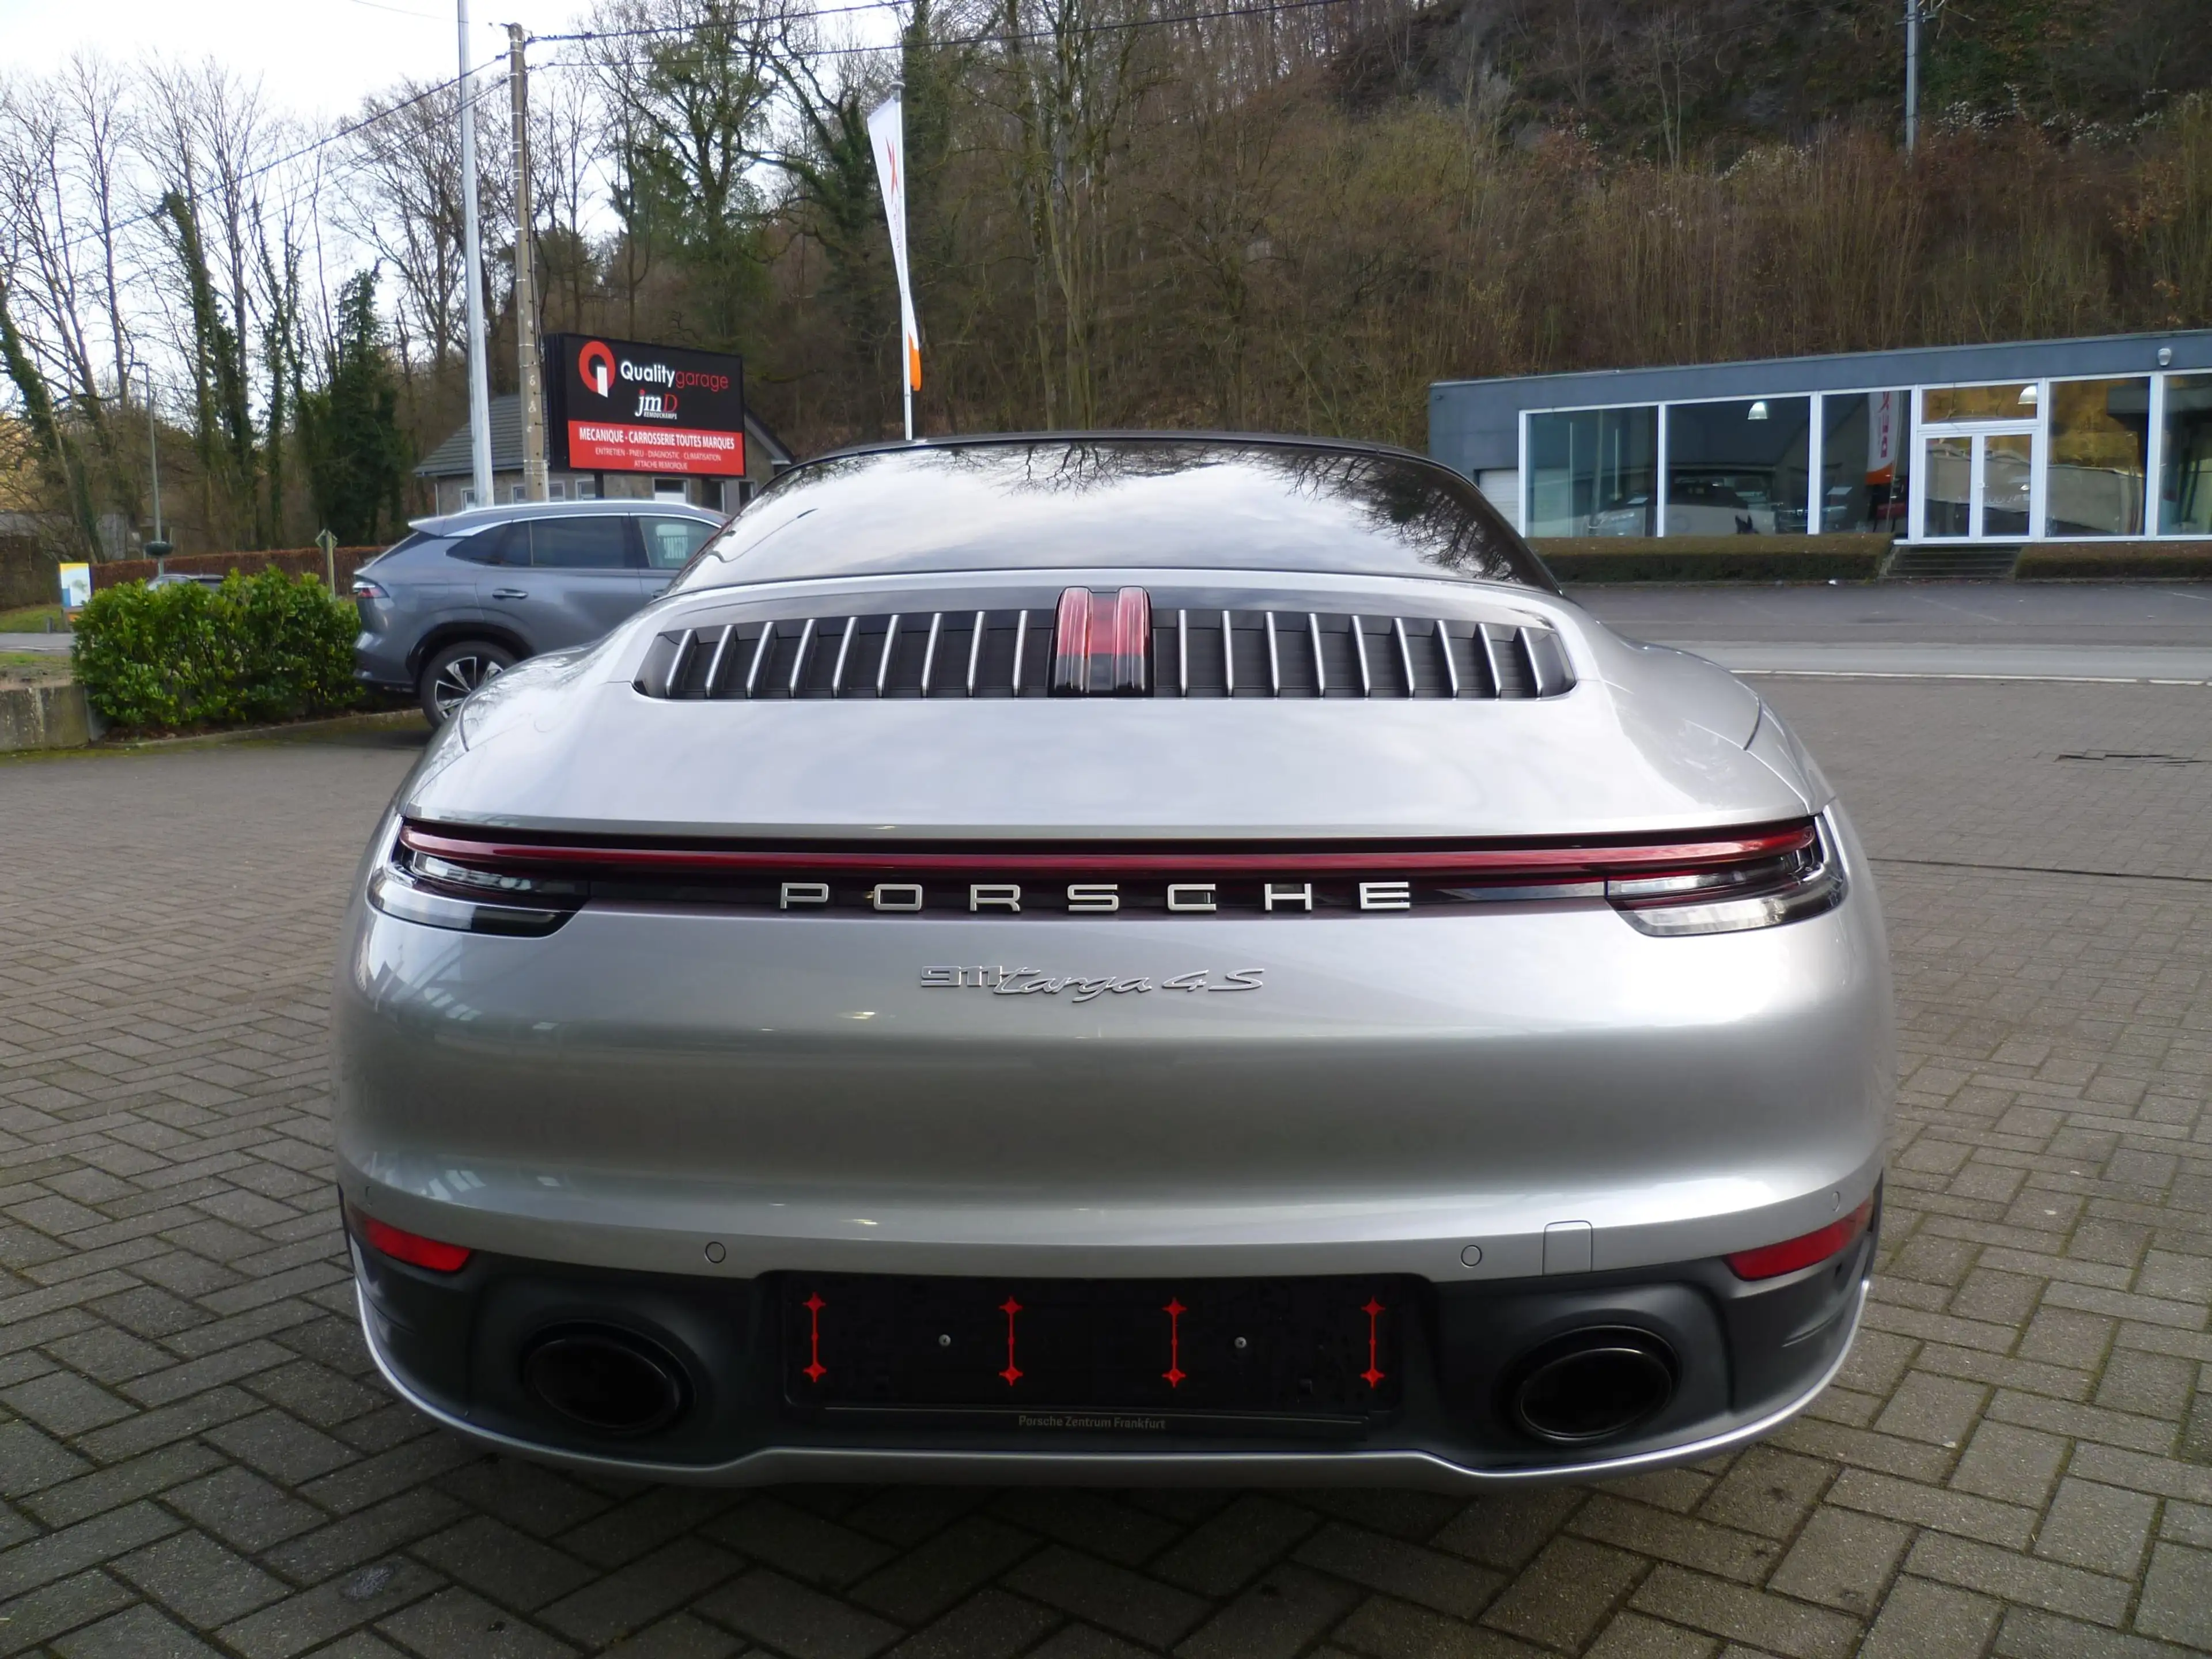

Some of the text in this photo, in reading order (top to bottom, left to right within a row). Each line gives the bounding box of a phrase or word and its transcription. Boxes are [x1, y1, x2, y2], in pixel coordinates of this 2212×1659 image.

[579, 427, 734, 450] MECANIQUE CARROSSERIE TOUTES MARQUES
[596, 447, 625, 456] ENTRETIEN
[648, 450, 680, 459] DIAGNOSTIC
[684, 452, 721, 461] CLIMATISATION
[634, 460, 657, 468] ATTACHE
[780, 881, 1410, 911] PORSCHE
[1018, 1415, 1166, 1429] Porsche Zentrum Frankfurt
